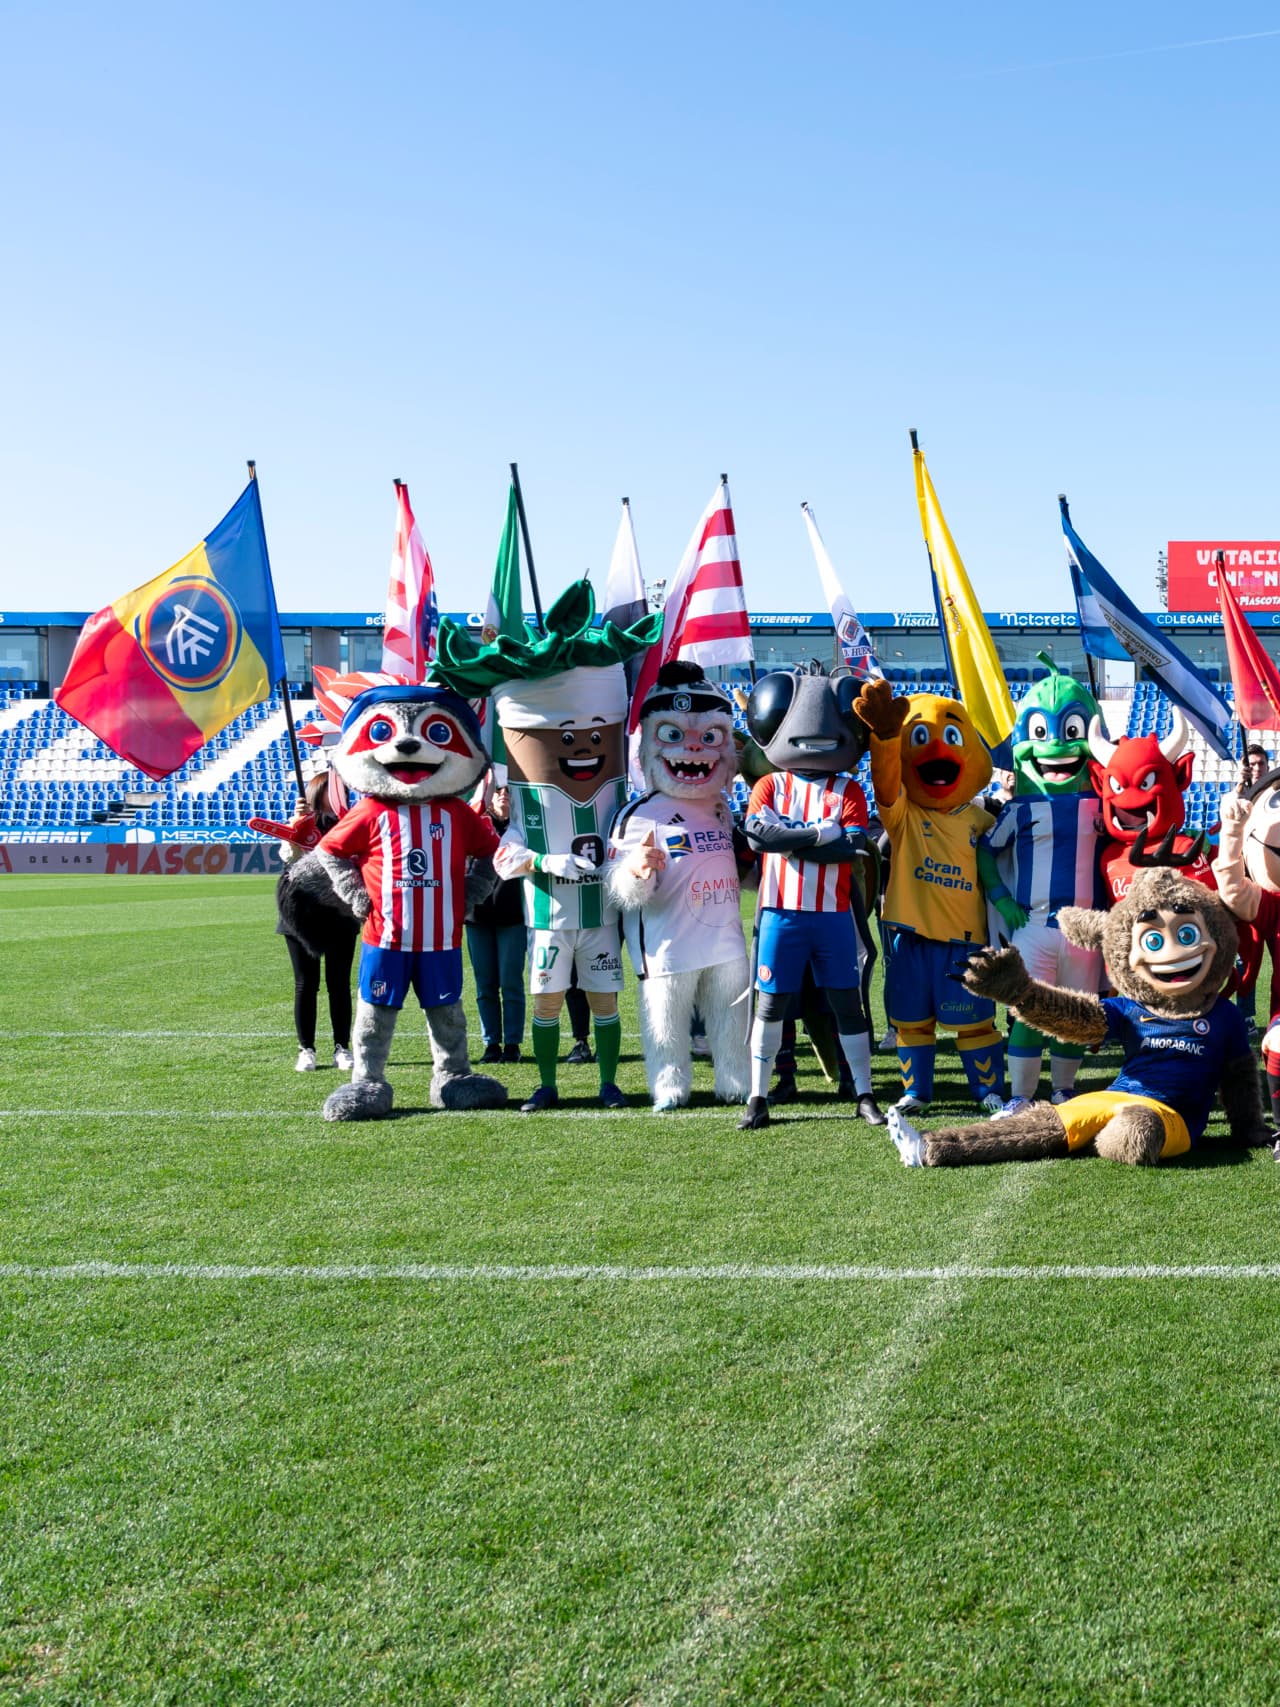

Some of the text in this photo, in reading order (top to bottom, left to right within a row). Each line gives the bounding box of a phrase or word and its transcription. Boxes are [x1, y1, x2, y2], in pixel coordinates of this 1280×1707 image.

[749, 615, 813, 624] OTOENERGY
[1001, 612, 1077, 626] Motoreto
[29, 843, 284, 874] DE LAS MASCOTAS
[924, 856, 962, 876] Gran
[914, 866, 973, 892] Canaria
[535, 945, 561, 970] 07
[1150, 1038, 1206, 1056] MORABANC
